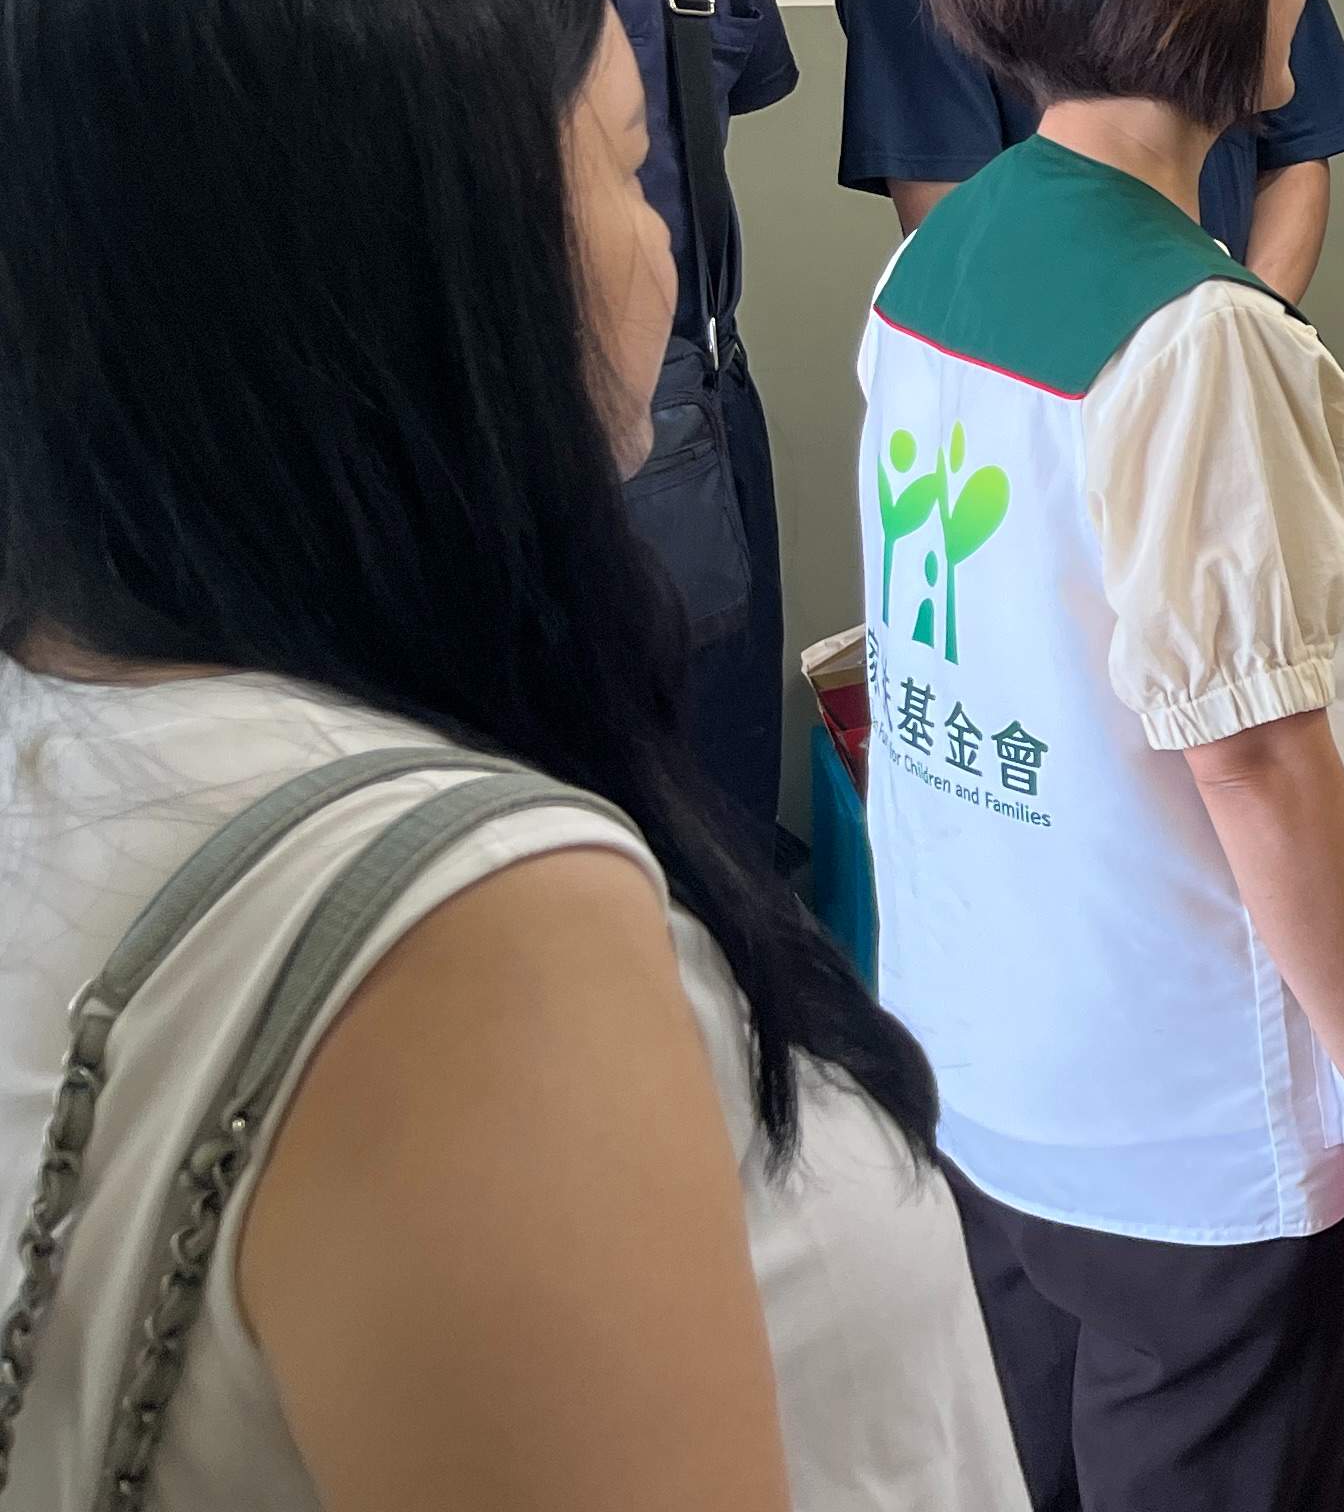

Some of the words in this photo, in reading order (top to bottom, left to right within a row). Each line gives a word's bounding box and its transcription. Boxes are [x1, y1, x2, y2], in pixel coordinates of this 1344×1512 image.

[904, 754, 951, 794] Children
[955, 784, 980, 805] and
[985, 791, 1052, 828] Families
